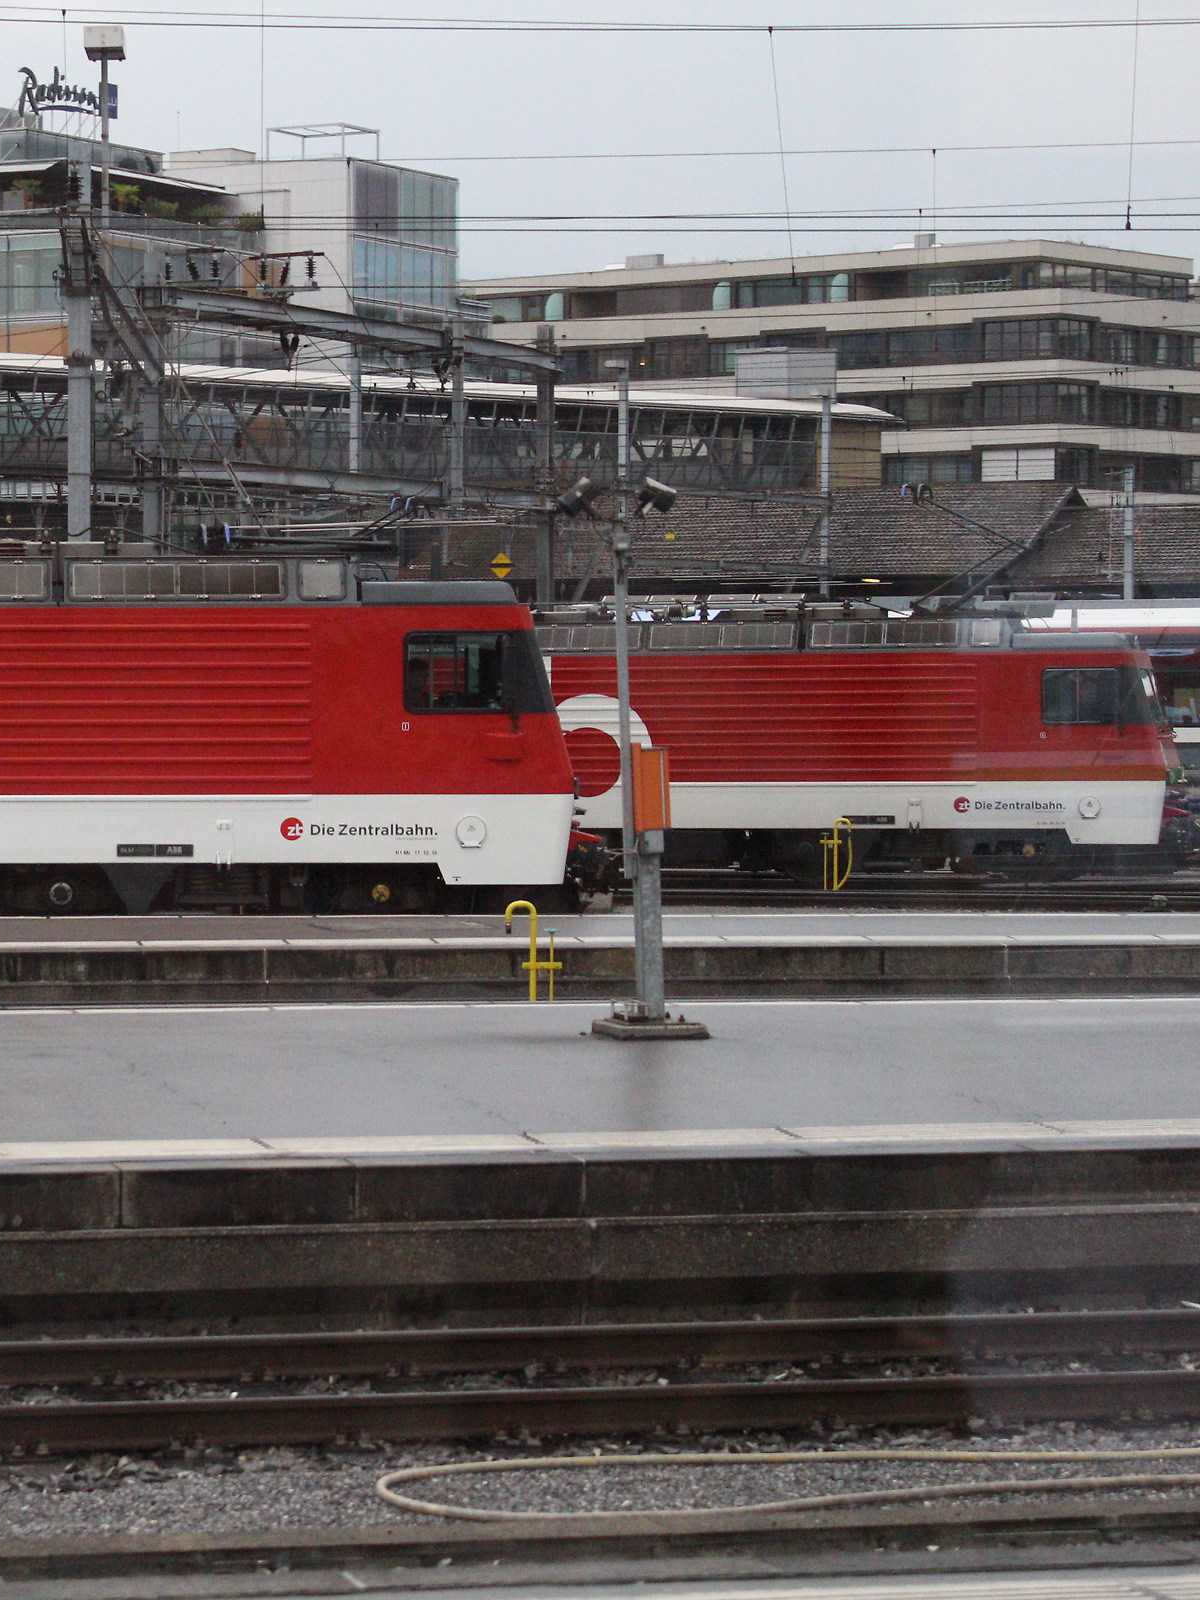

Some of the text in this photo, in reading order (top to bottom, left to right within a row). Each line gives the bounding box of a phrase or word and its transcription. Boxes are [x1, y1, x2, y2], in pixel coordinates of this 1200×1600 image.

[18, 66, 100, 117] Radisson
[974, 801, 1067, 811] Die Zentralbahn.
[310, 823, 439, 836] Die Zentralbahn.
